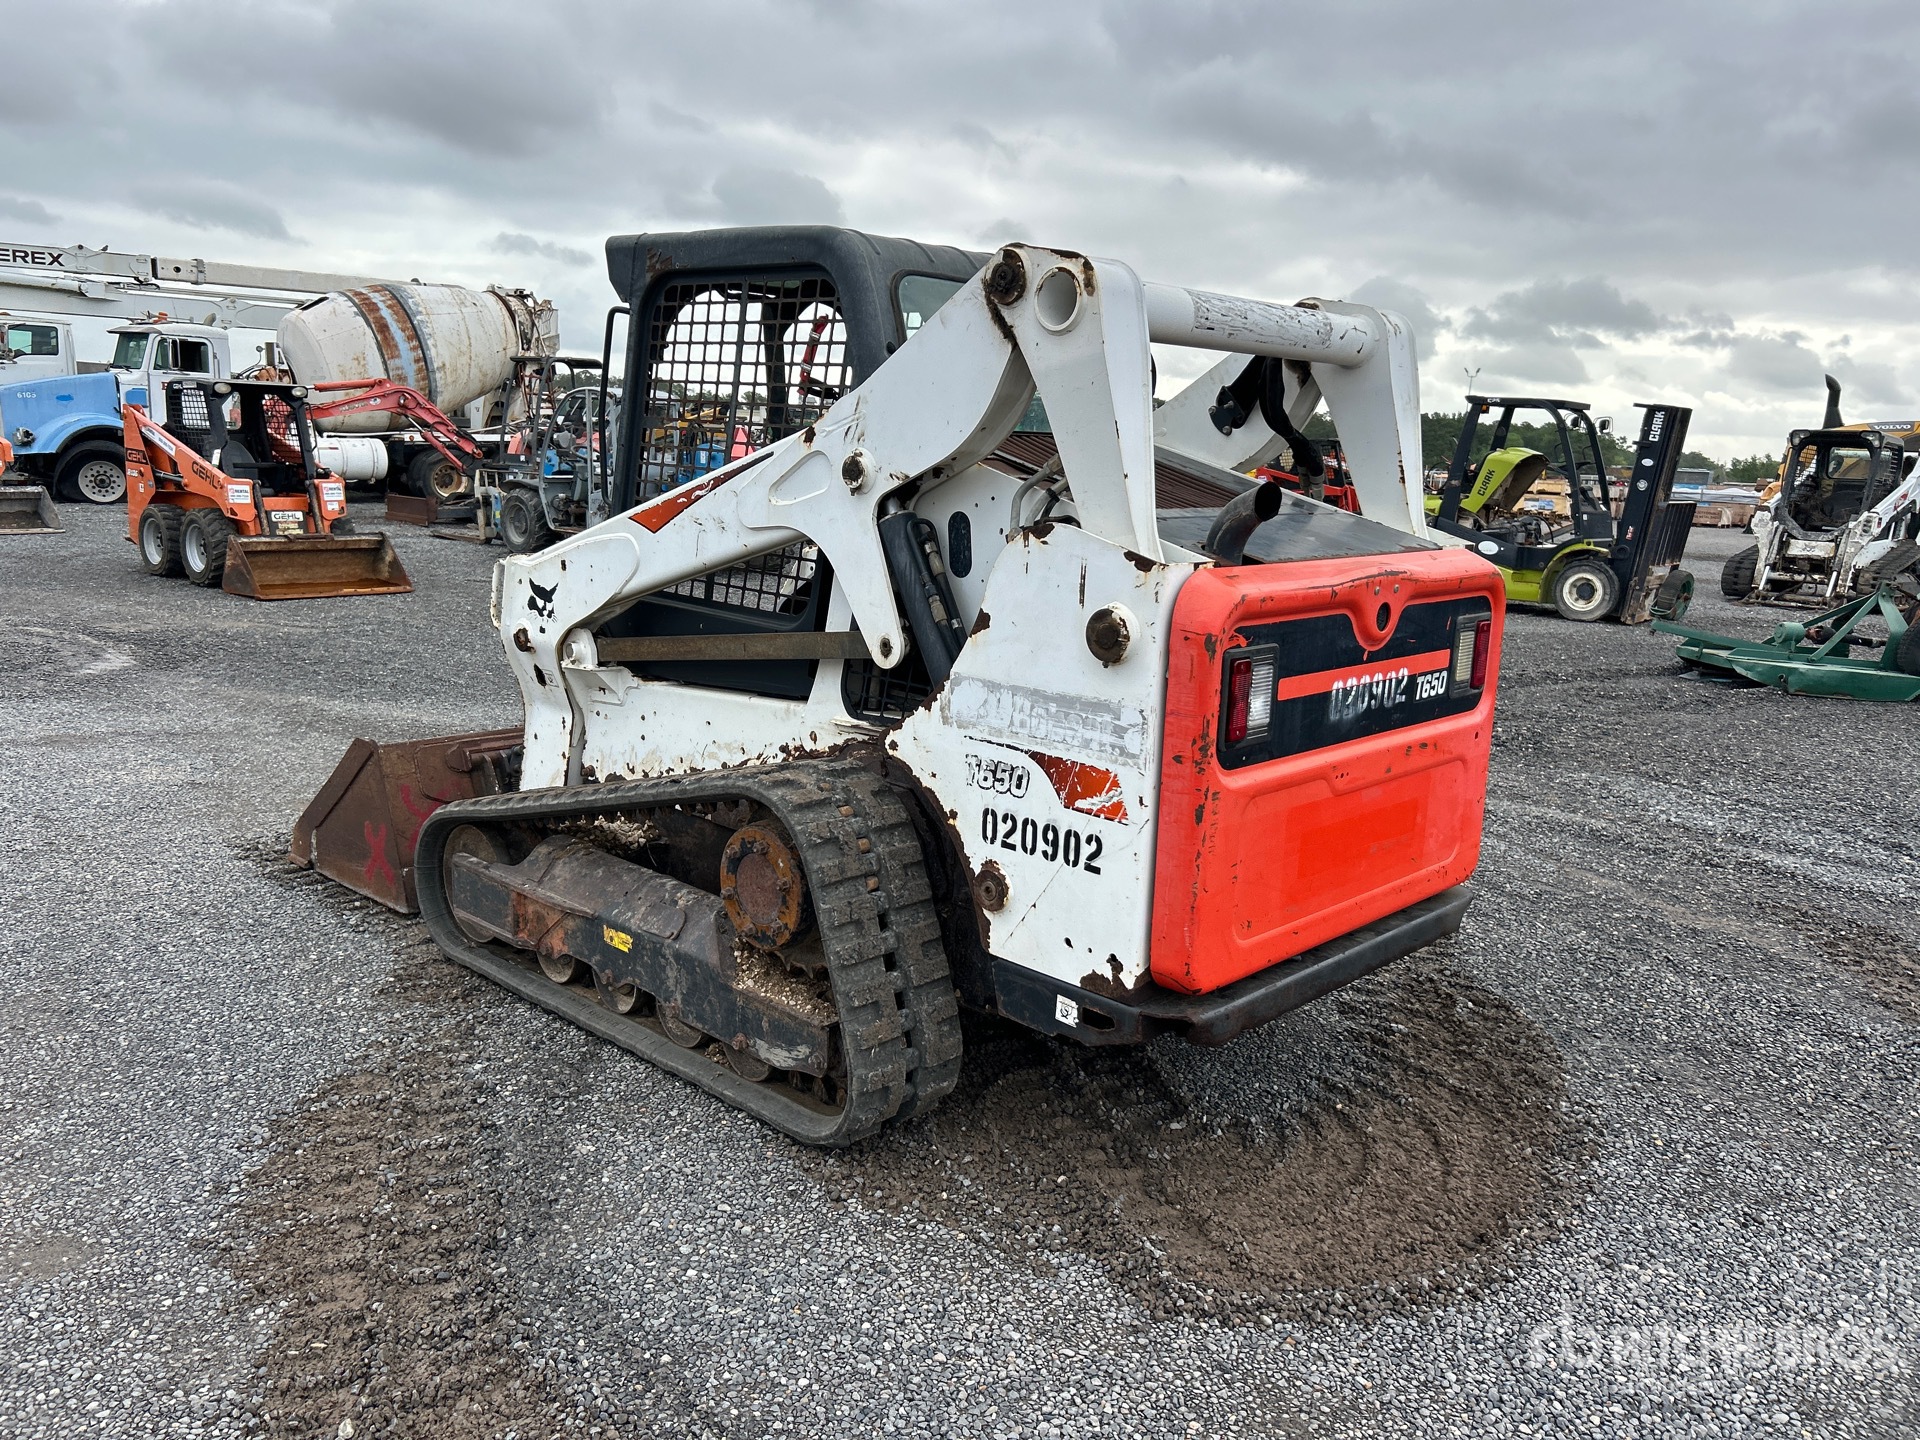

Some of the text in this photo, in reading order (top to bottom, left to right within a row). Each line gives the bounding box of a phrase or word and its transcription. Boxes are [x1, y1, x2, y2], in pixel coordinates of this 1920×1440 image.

[1649, 411, 1665, 442] CLARK
[127, 450, 146, 463] GEHL
[192, 460, 219, 490] GEHL
[1478, 469, 1495, 496] CLARK
[273, 512, 300, 520] GEHL
[1329, 667, 1448, 720] 020902 T650
[966, 754, 1030, 798] T650
[982, 808, 1103, 875] 020902
